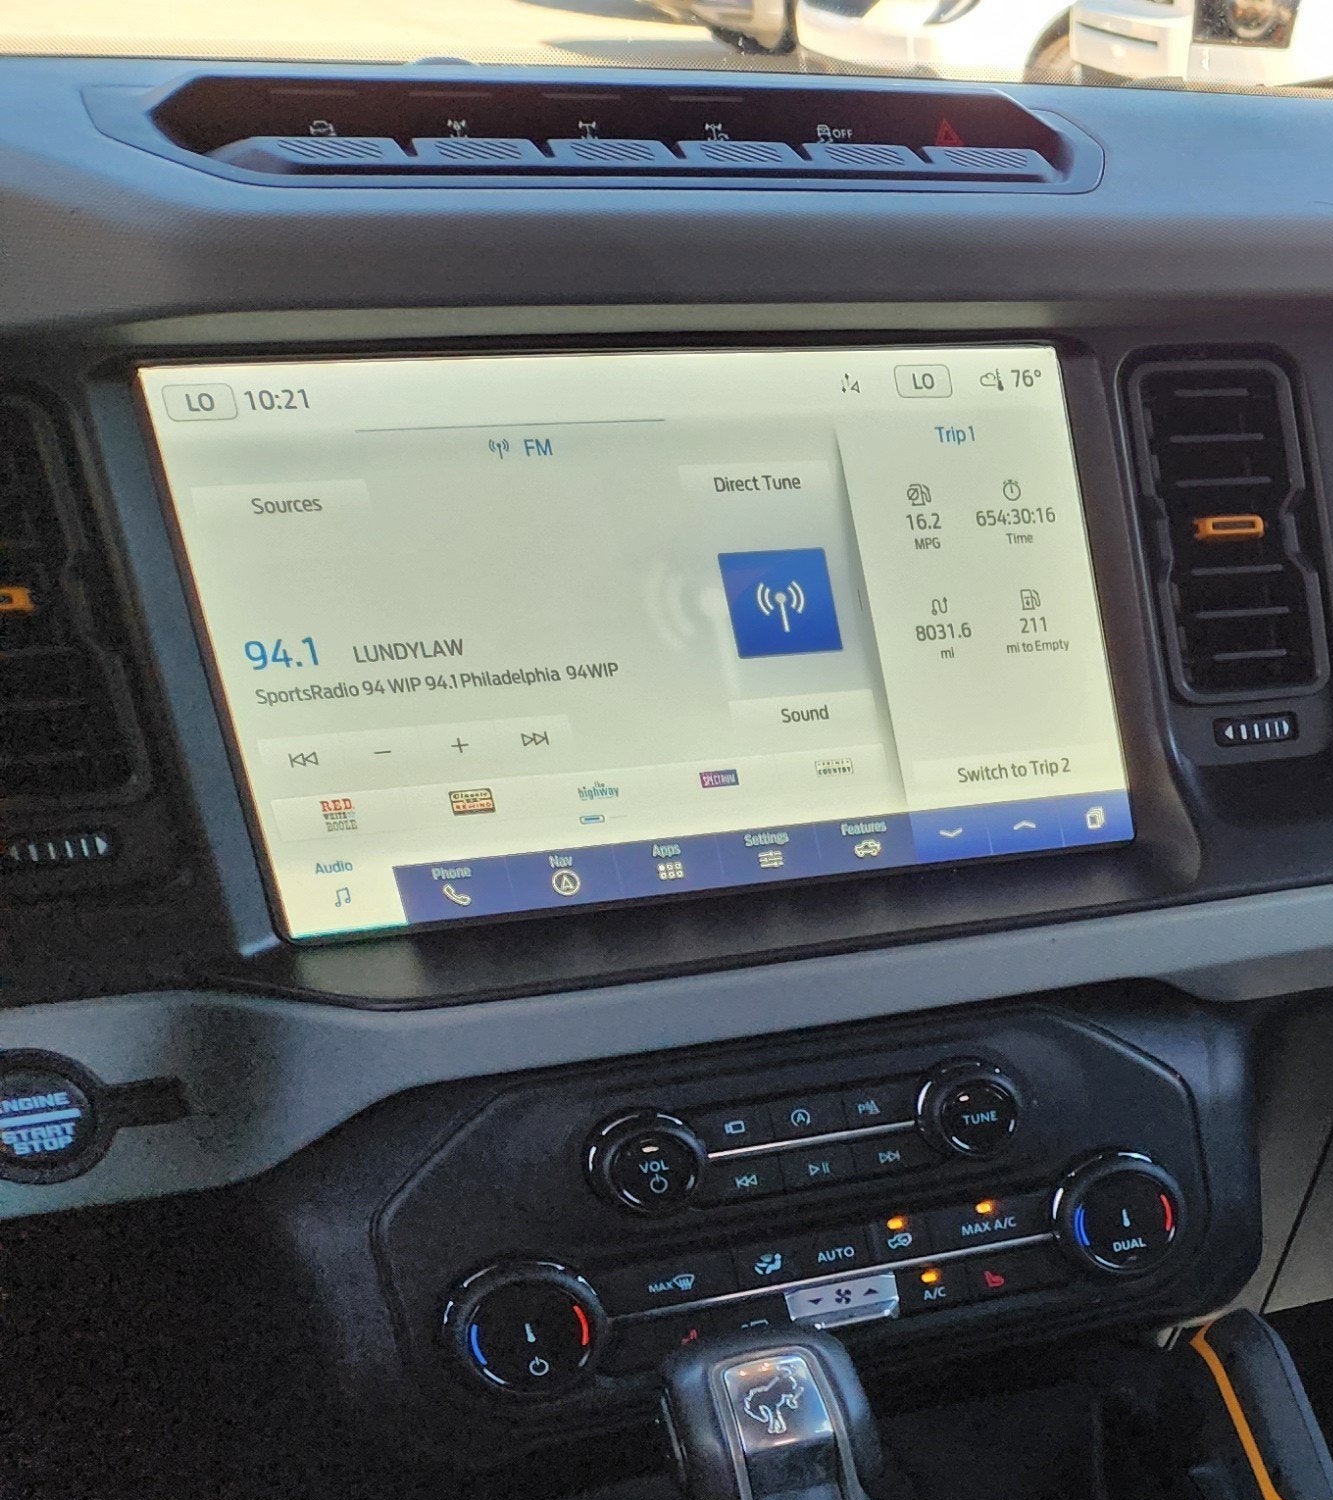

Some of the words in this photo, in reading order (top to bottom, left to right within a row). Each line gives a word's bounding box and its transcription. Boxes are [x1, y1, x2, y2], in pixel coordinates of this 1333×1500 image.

[833, 128, 853, 140] OFF
[911, 372, 935, 390] LO
[185, 392, 215, 412] LO
[243, 388, 310, 411] 10:21
[934, 425, 967, 446] Trip
[523, 438, 554, 457] FM
[713, 475, 761, 493] Direct
[765, 474, 802, 491] Tune
[251, 497, 323, 515] Sources
[906, 512, 942, 531] 16.2
[975, 506, 1057, 528] 654:30:16
[914, 537, 942, 551] MPG
[1005, 532, 1034, 545] Time
[915, 621, 972, 642] 8031.6
[1019, 615, 1048, 634] 211
[244, 636, 320, 672] 94.1
[352, 637, 463, 664] LUNDYLAW
[940, 646, 955, 659] mi
[1006, 642, 1021, 654] mi
[1022, 641, 1034, 653] to
[1034, 638, 1070, 653] Empty
[254, 681, 361, 708] SportsRadio
[361, 679, 386, 696] 94
[387, 676, 422, 695] WIP
[425, 674, 459, 692] 94.1
[459, 667, 562, 689] Philadelphia
[565, 661, 620, 681] 94WIP
[780, 704, 830, 724] Sound
[818, 765, 853, 776] COUNTRY
[957, 763, 1008, 784] Switch
[1011, 763, 1028, 778] to
[1029, 759, 1060, 778] Trip
[1060, 757, 1071, 774] 2
[702, 773, 736, 787] SPECTRUM
[577, 785, 620, 801] highway
[319, 798, 352, 813] RED
[454, 801, 493, 811] REWIND
[840, 820, 888, 836] Features
[743, 831, 790, 848] Settings
[651, 843, 681, 859] Apps
[315, 860, 354, 875] Audio
[548, 854, 573, 869] Nav
[431, 866, 473, 881] Phone
[0, 1091, 71, 1115] NGINE
[961, 1109, 998, 1127] TUNE
[2, 1121, 76, 1145] START
[13, 1134, 74, 1156] STOP
[638, 1160, 670, 1175] VOL
[960, 1218, 991, 1238] MAX
[992, 1215, 1018, 1231] A/C
[1111, 1236, 1148, 1254] DUAL
[816, 1245, 856, 1264] AUTO
[648, 1279, 674, 1295] MAX
[922, 1285, 947, 1301] A/C
